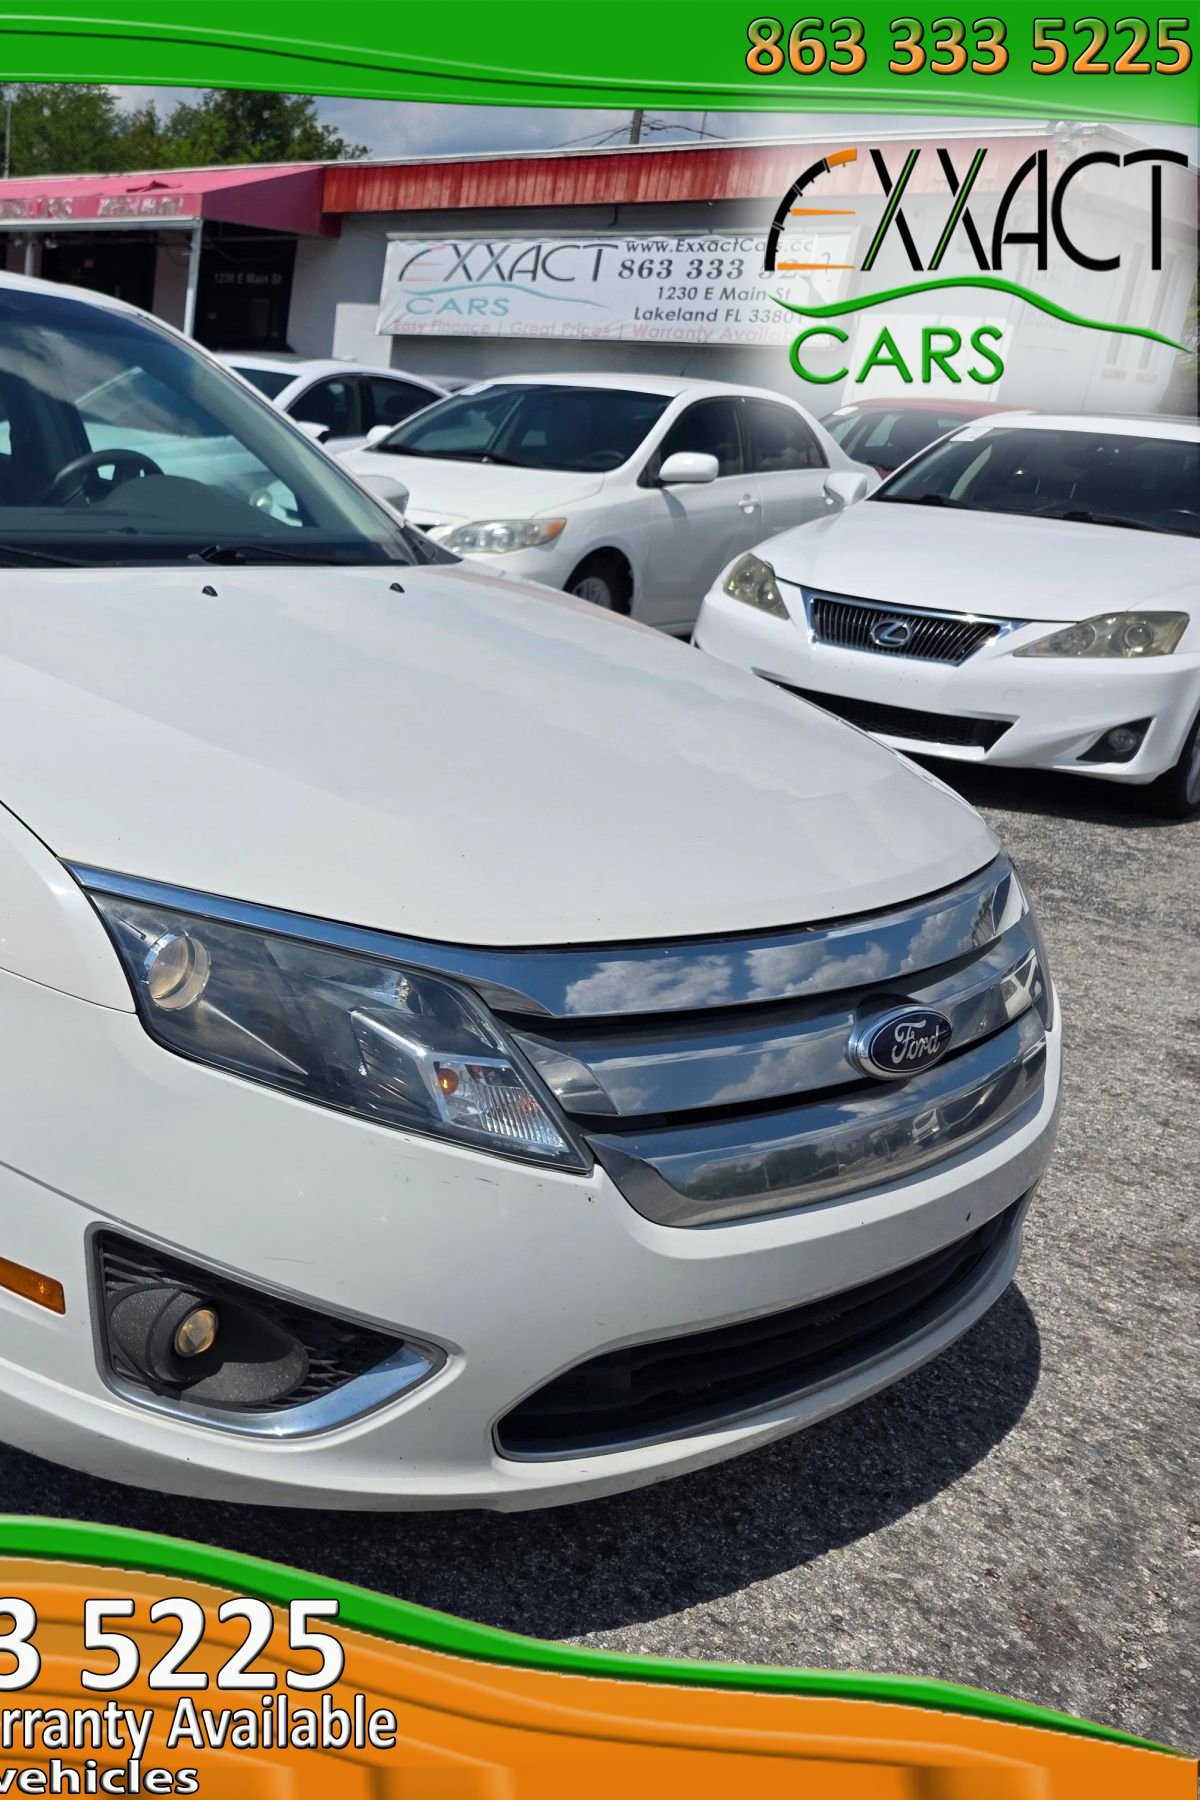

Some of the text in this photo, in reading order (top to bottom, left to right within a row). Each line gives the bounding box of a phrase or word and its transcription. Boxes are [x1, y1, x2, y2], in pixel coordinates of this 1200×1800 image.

[398, 243, 619, 283] EXXACT
[618, 258, 673, 280] 863
[686, 258, 745, 280] 333
[657, 285, 791, 301] 1230 E Main St
[405, 298, 511, 316] CARS
[634, 307, 719, 322] Lakeland
[724, 308, 743, 323] FL
[633, 325, 713, 343] Warranty
[891, 1019, 942, 1064] Ford
